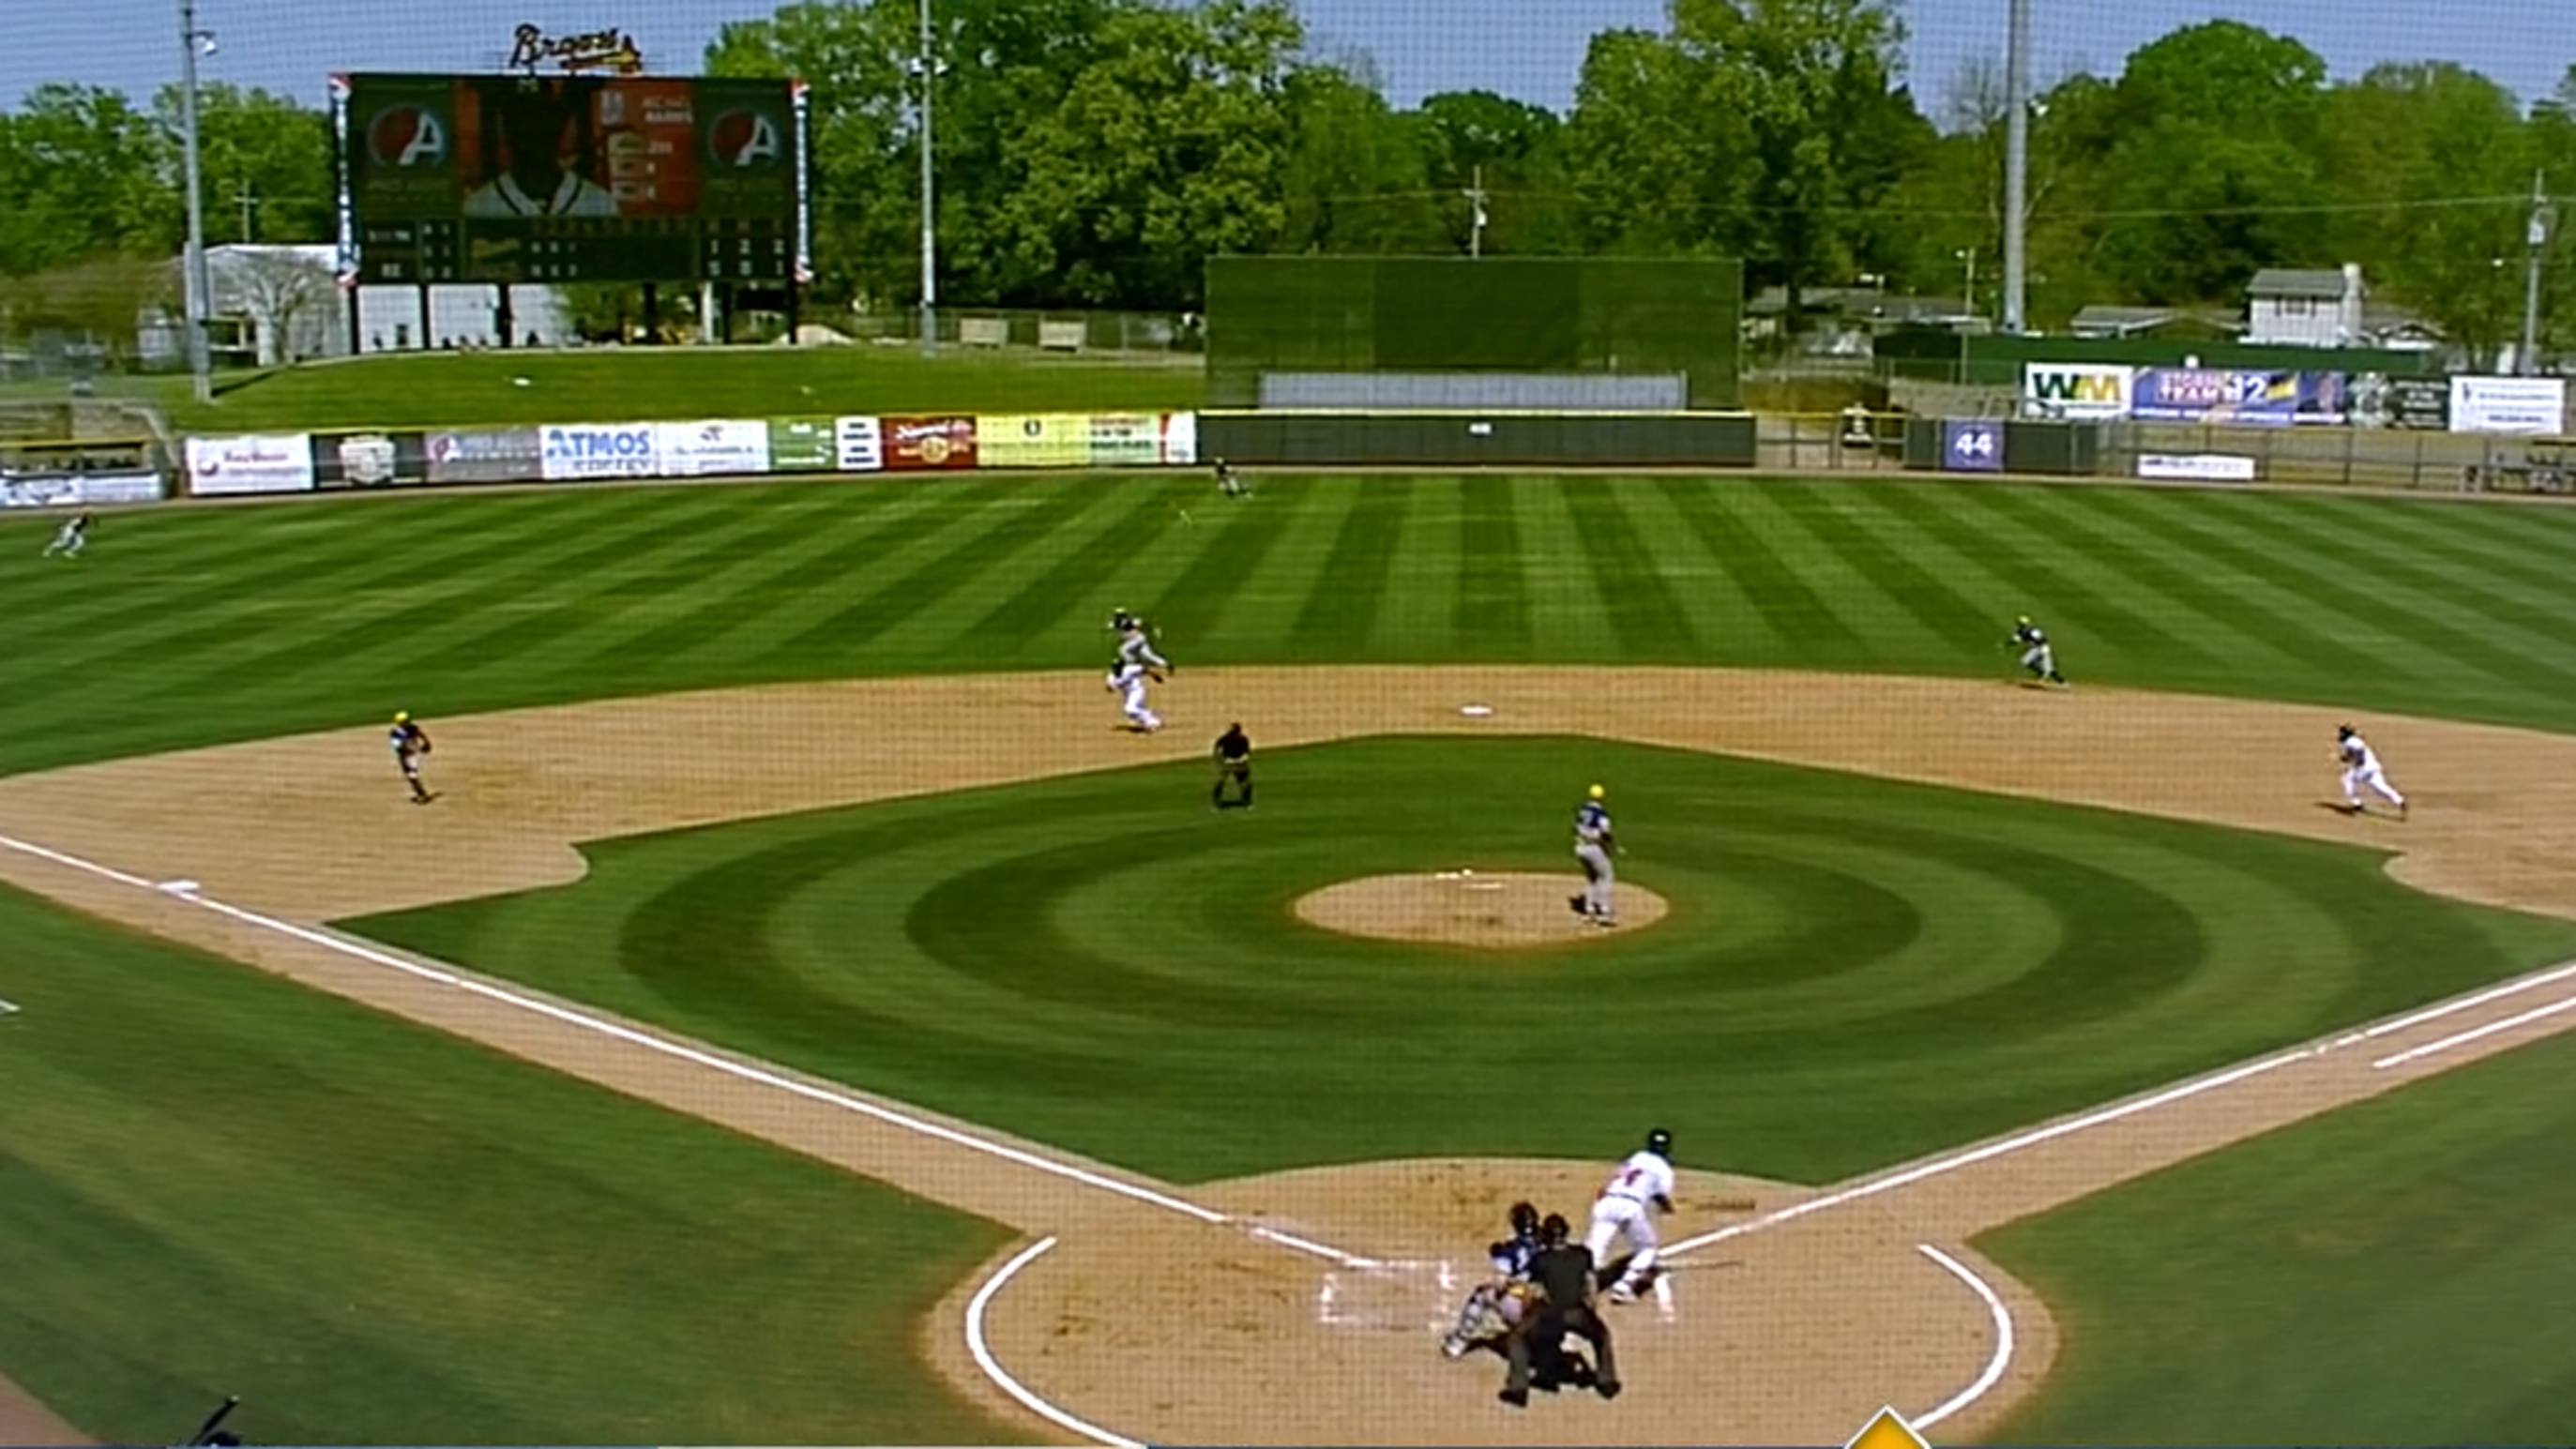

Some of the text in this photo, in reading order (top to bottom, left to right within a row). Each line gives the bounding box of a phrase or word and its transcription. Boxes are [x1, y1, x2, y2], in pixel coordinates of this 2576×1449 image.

[2033, 372, 2122, 401] WM
[2160, 385, 2220, 402] TEAM
[2230, 376, 2266, 403] 12
[546, 430, 651, 458] ATMOS
[1956, 431, 1993, 457] 44
